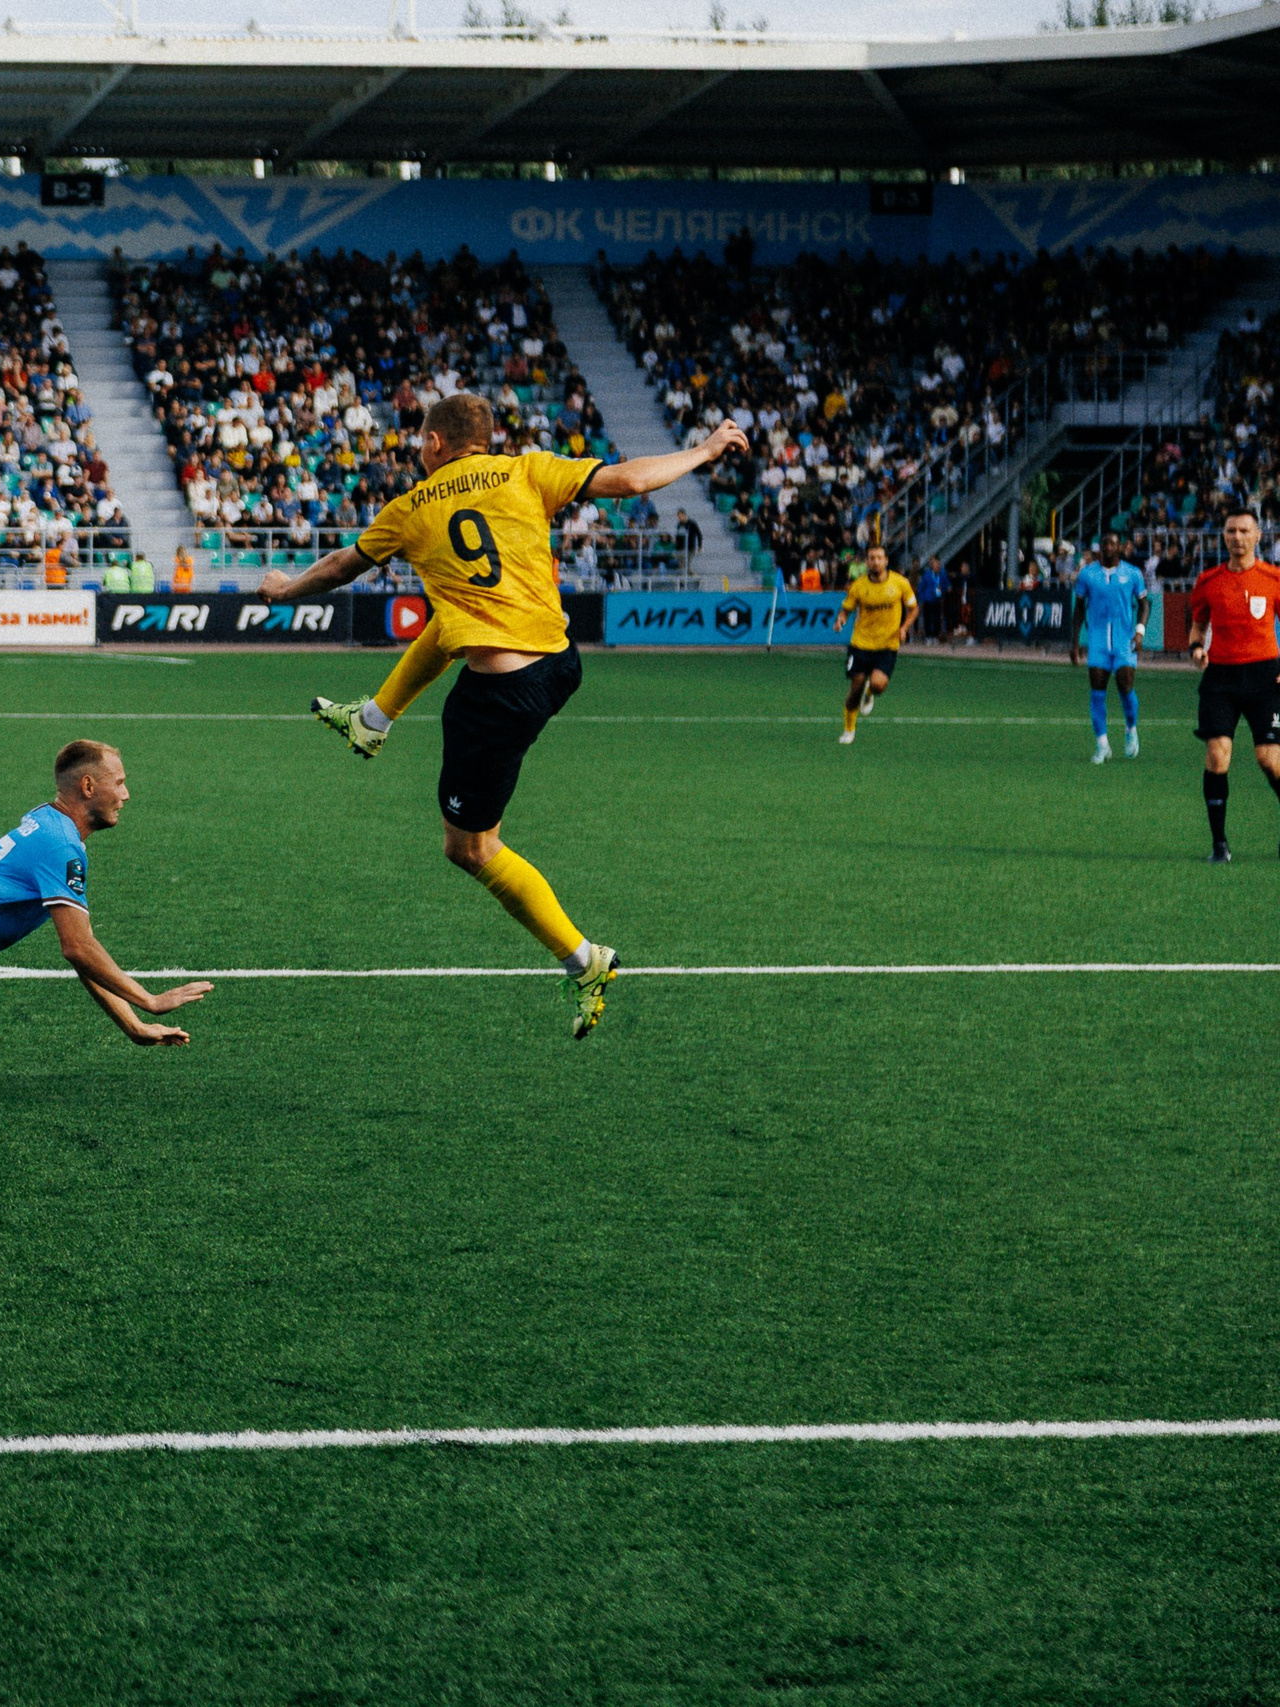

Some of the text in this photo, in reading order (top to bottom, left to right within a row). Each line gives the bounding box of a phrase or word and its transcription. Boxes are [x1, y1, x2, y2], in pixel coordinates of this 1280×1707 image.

[510, 206, 872, 243] ФК ЧЕЛЯБИНСК
[411, 472, 510, 512] КАМЕНЩИКОВ
[448, 509, 502, 588] 9
[0, 611, 19, 625] за
[28, 608, 88, 625] нами!
[112, 605, 210, 631] PARI
[236, 605, 334, 631] PARI
[618, 608, 705, 629] ЛИГА
[762, 607, 834, 629] PAR
[985, 602, 1017, 627] ЛИГА
